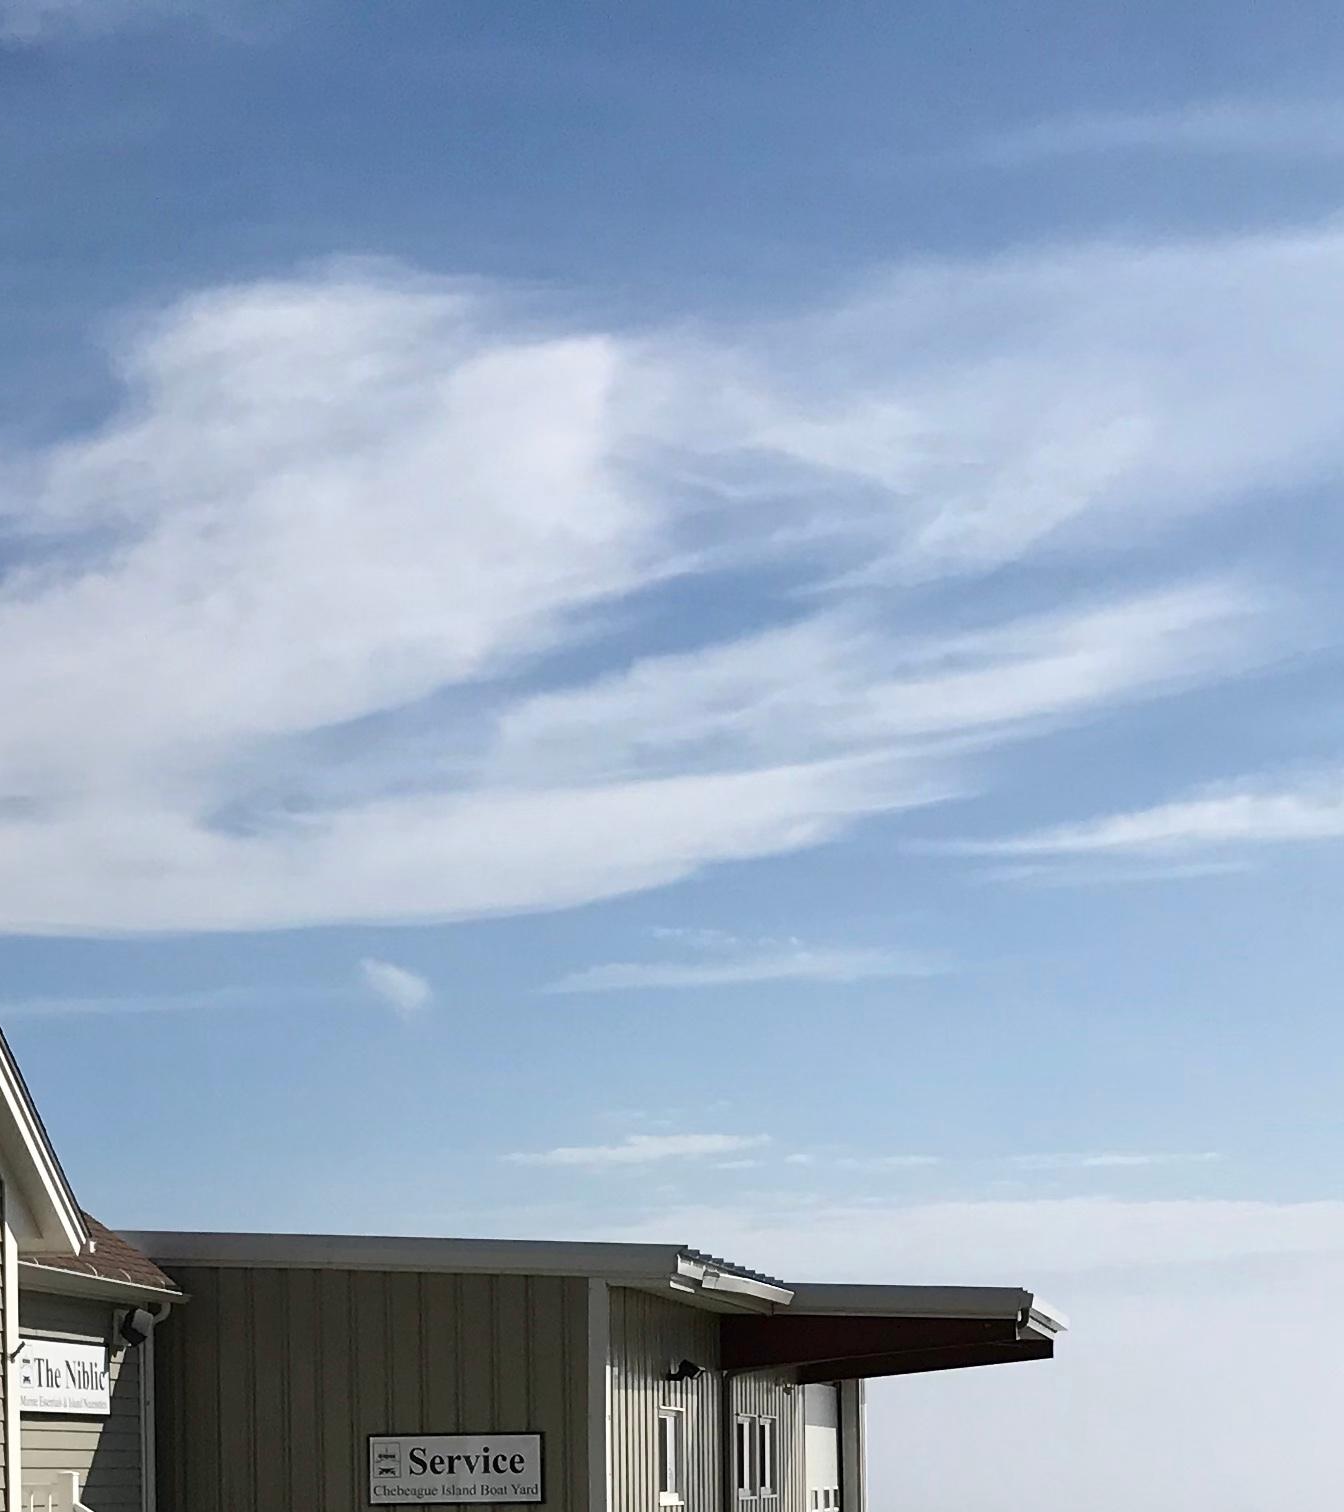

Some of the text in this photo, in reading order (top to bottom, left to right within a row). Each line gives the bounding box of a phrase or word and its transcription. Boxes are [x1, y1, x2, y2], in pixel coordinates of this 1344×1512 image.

[34, 1357, 106, 1391] The Niblic
[408, 1446, 525, 1476] Service
[373, 1483, 539, 1499] Chebeague Island Boat Yard
